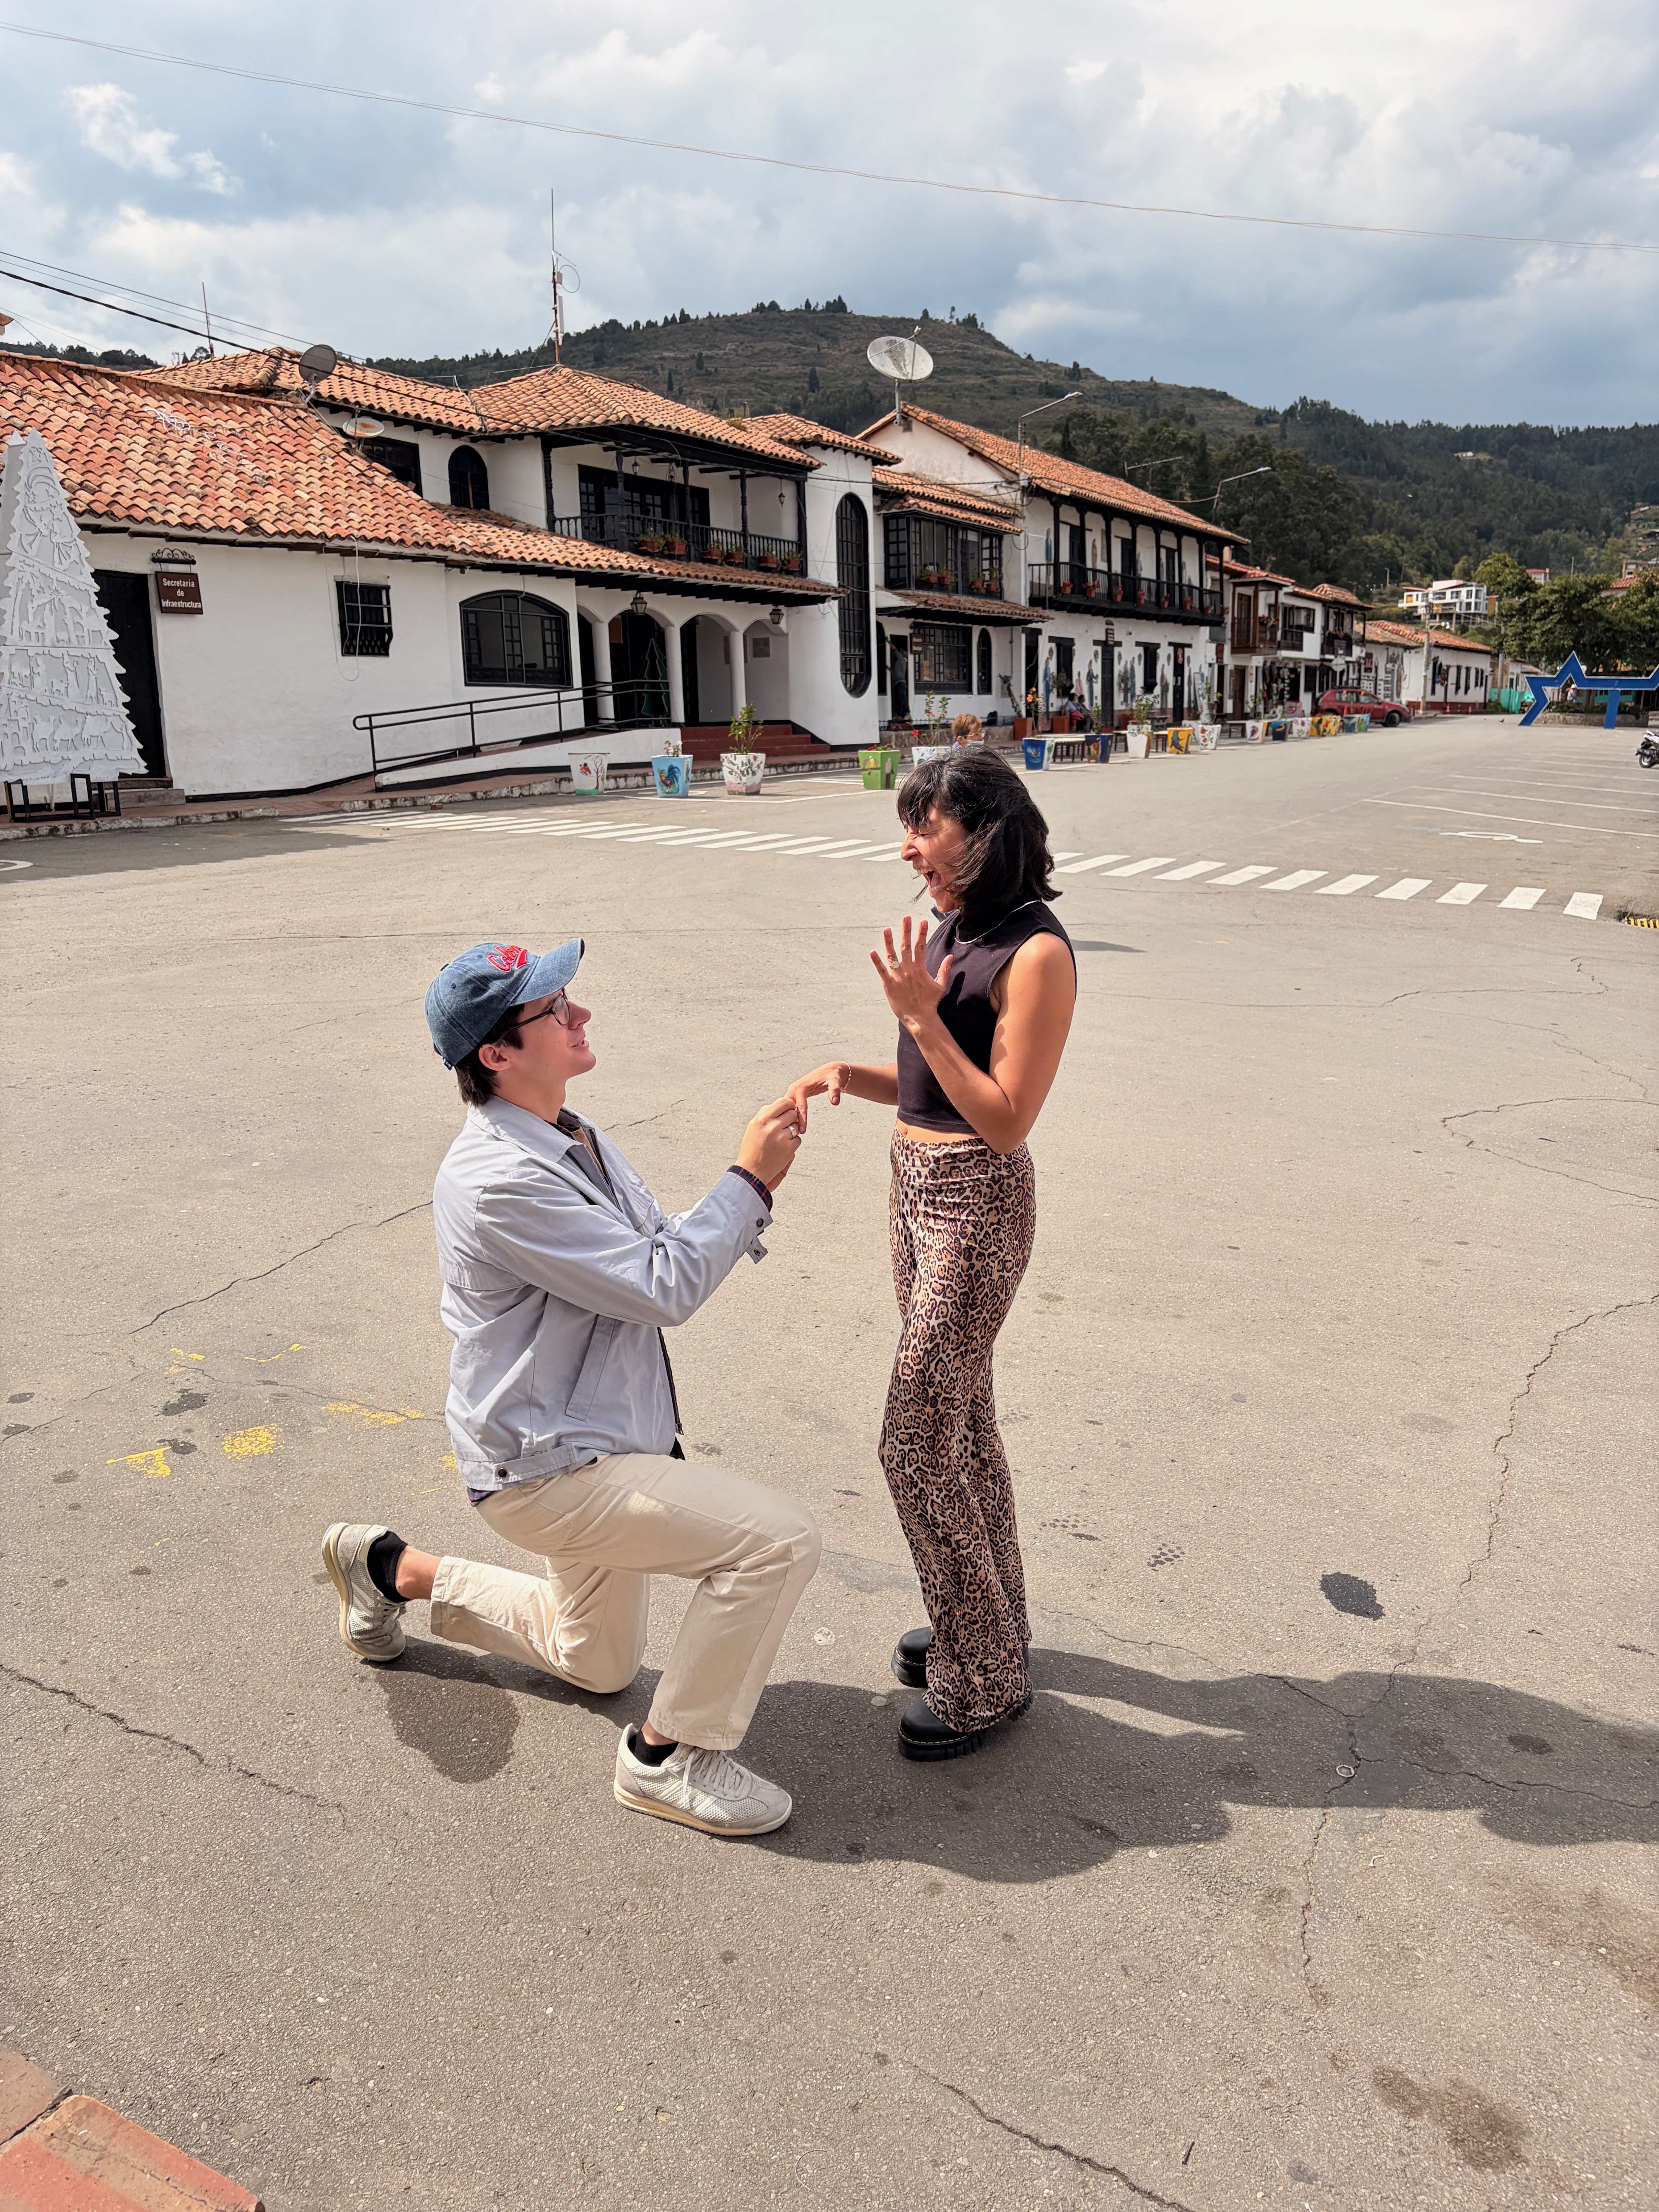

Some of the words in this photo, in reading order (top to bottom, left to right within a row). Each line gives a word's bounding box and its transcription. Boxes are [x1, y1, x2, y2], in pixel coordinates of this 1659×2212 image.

[163, 578, 195, 587] Secretaría
[177, 589, 184, 597] de
[161, 599, 201, 608] Infraestructura
